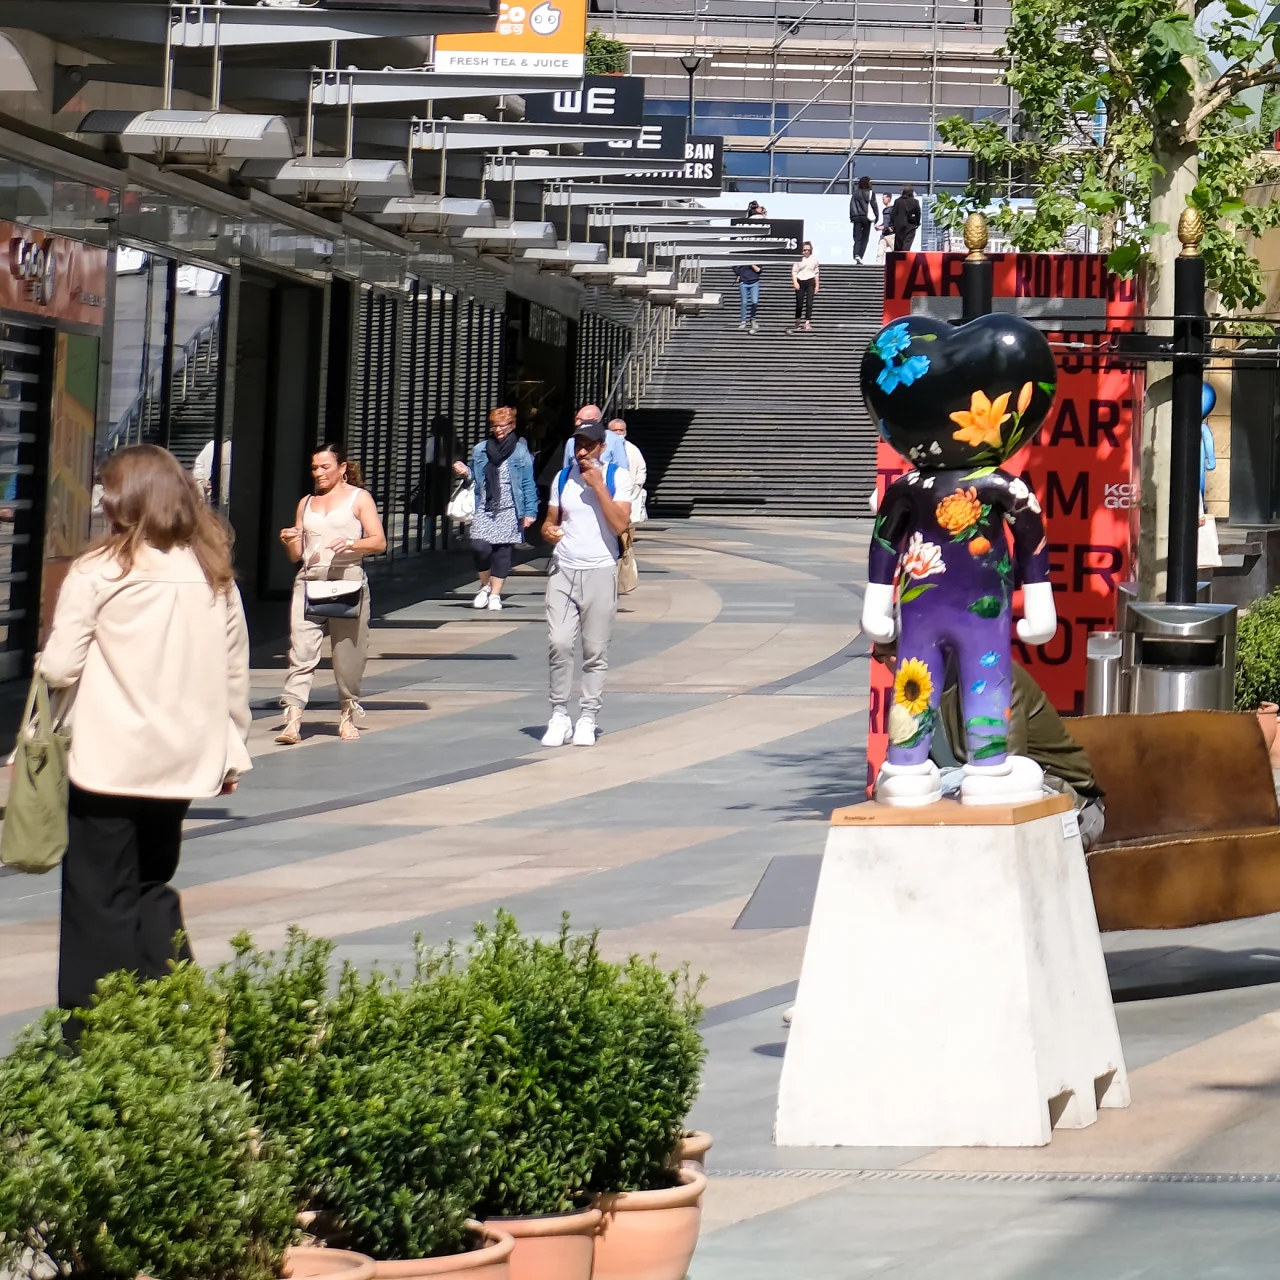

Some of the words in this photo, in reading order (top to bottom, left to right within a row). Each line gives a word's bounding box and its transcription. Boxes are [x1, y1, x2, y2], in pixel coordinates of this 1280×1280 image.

[498, 3, 526, 22] Co
[450, 57, 489, 66] FRESH
[493, 58, 516, 67] TEA
[521, 58, 528, 67] &
[533, 59, 569, 68] JUICE
[684, 143, 715, 160] BAN
